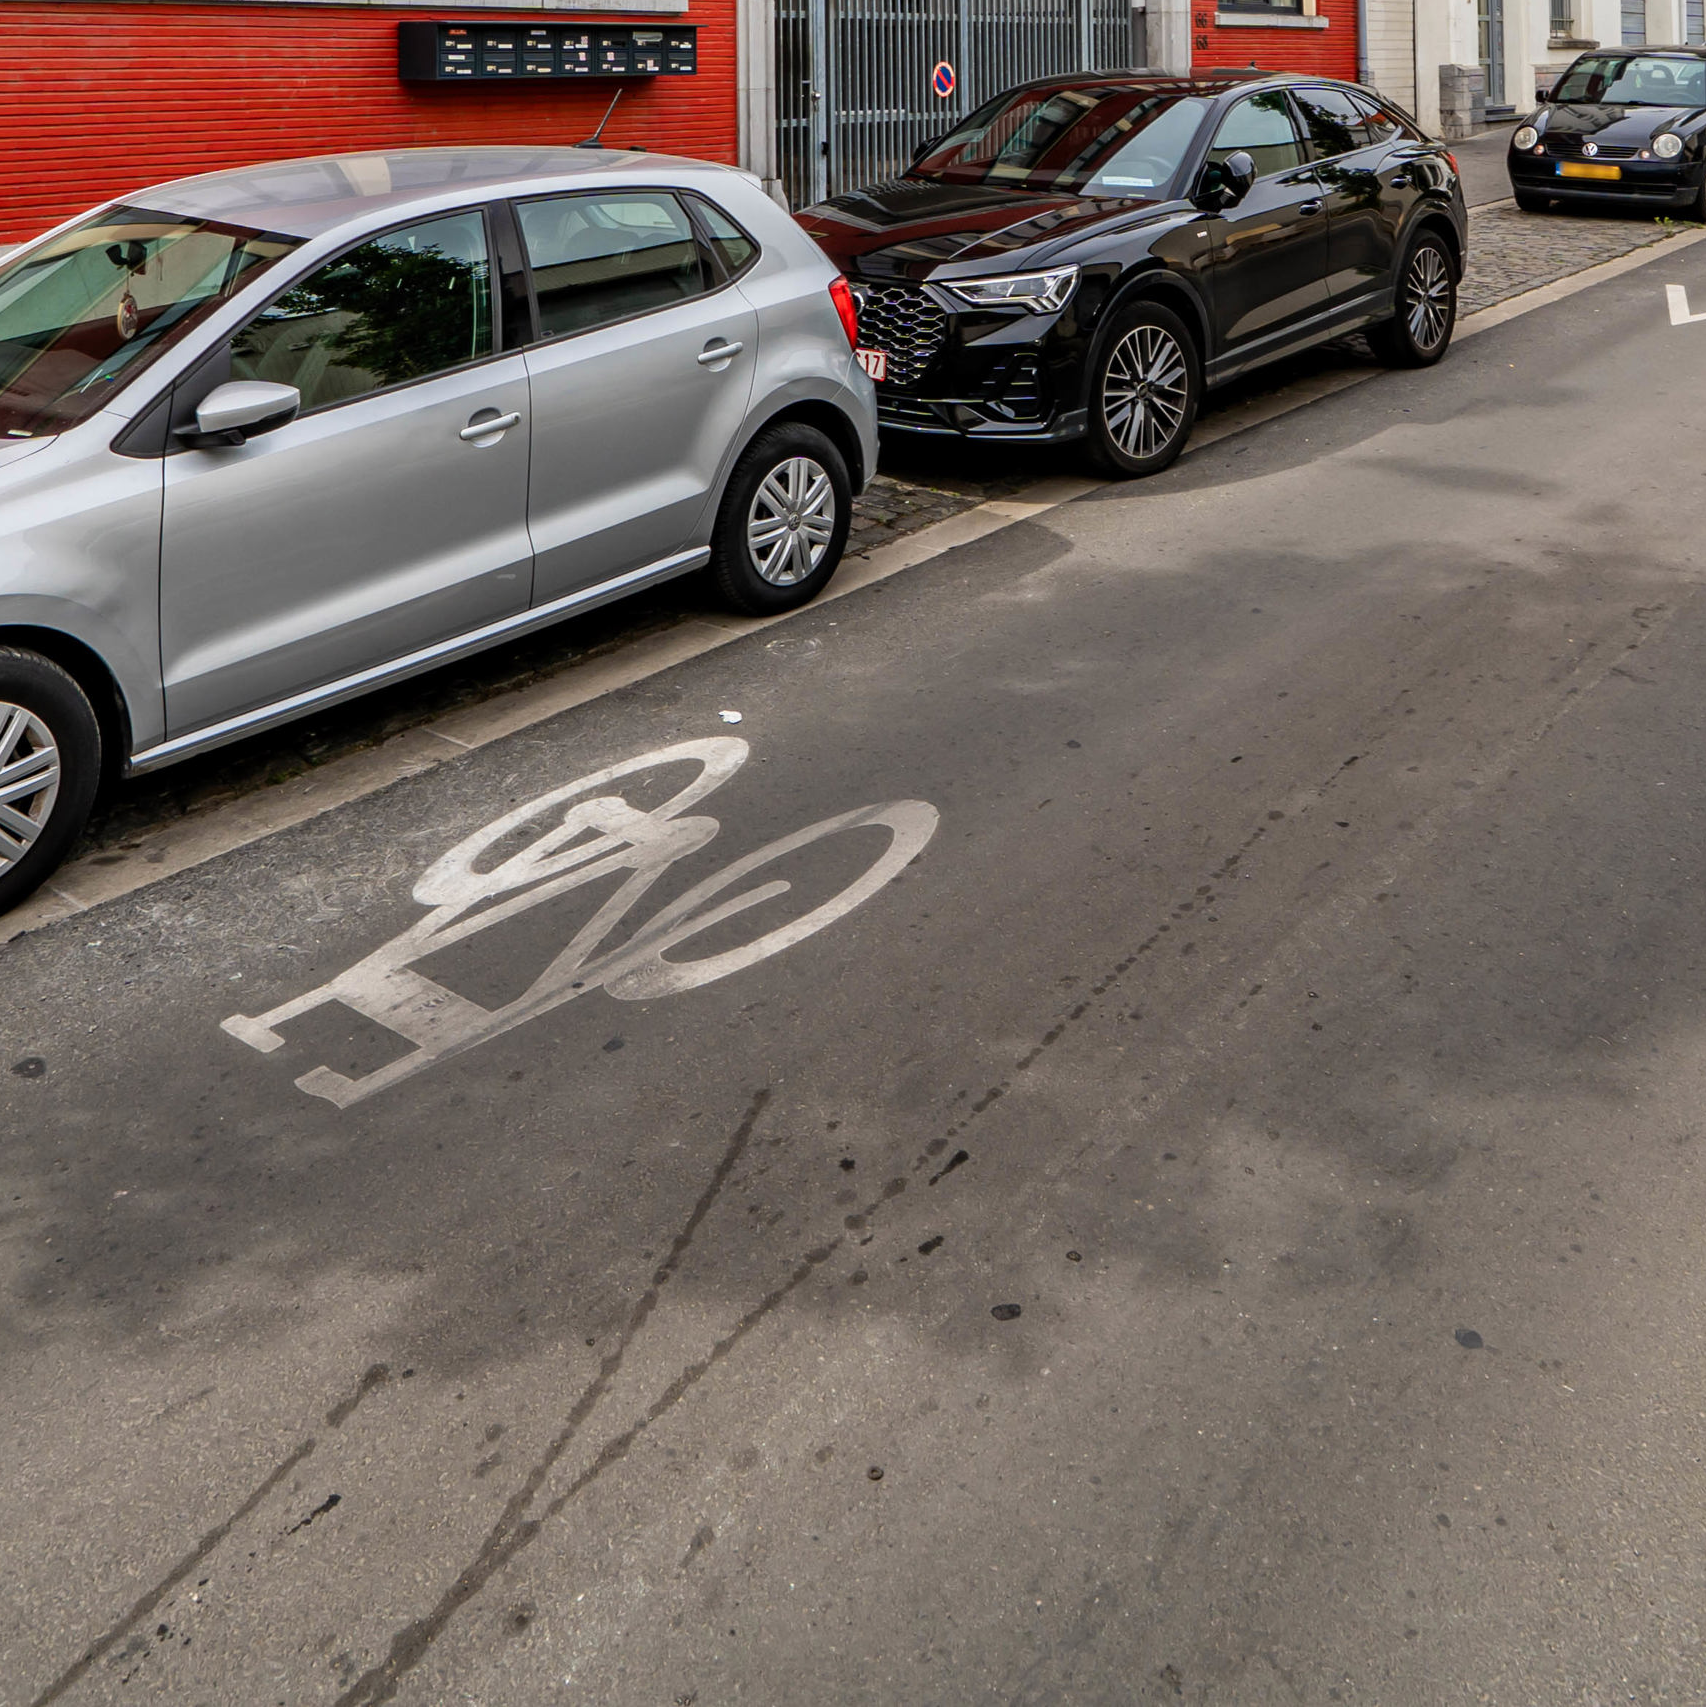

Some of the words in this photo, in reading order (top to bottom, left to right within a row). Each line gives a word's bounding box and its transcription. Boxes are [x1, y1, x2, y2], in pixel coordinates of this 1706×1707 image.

[1195, 12, 1207, 28] 66
[1582, 142, 1598, 157] VW
[856, 352, 880, 374] 17
